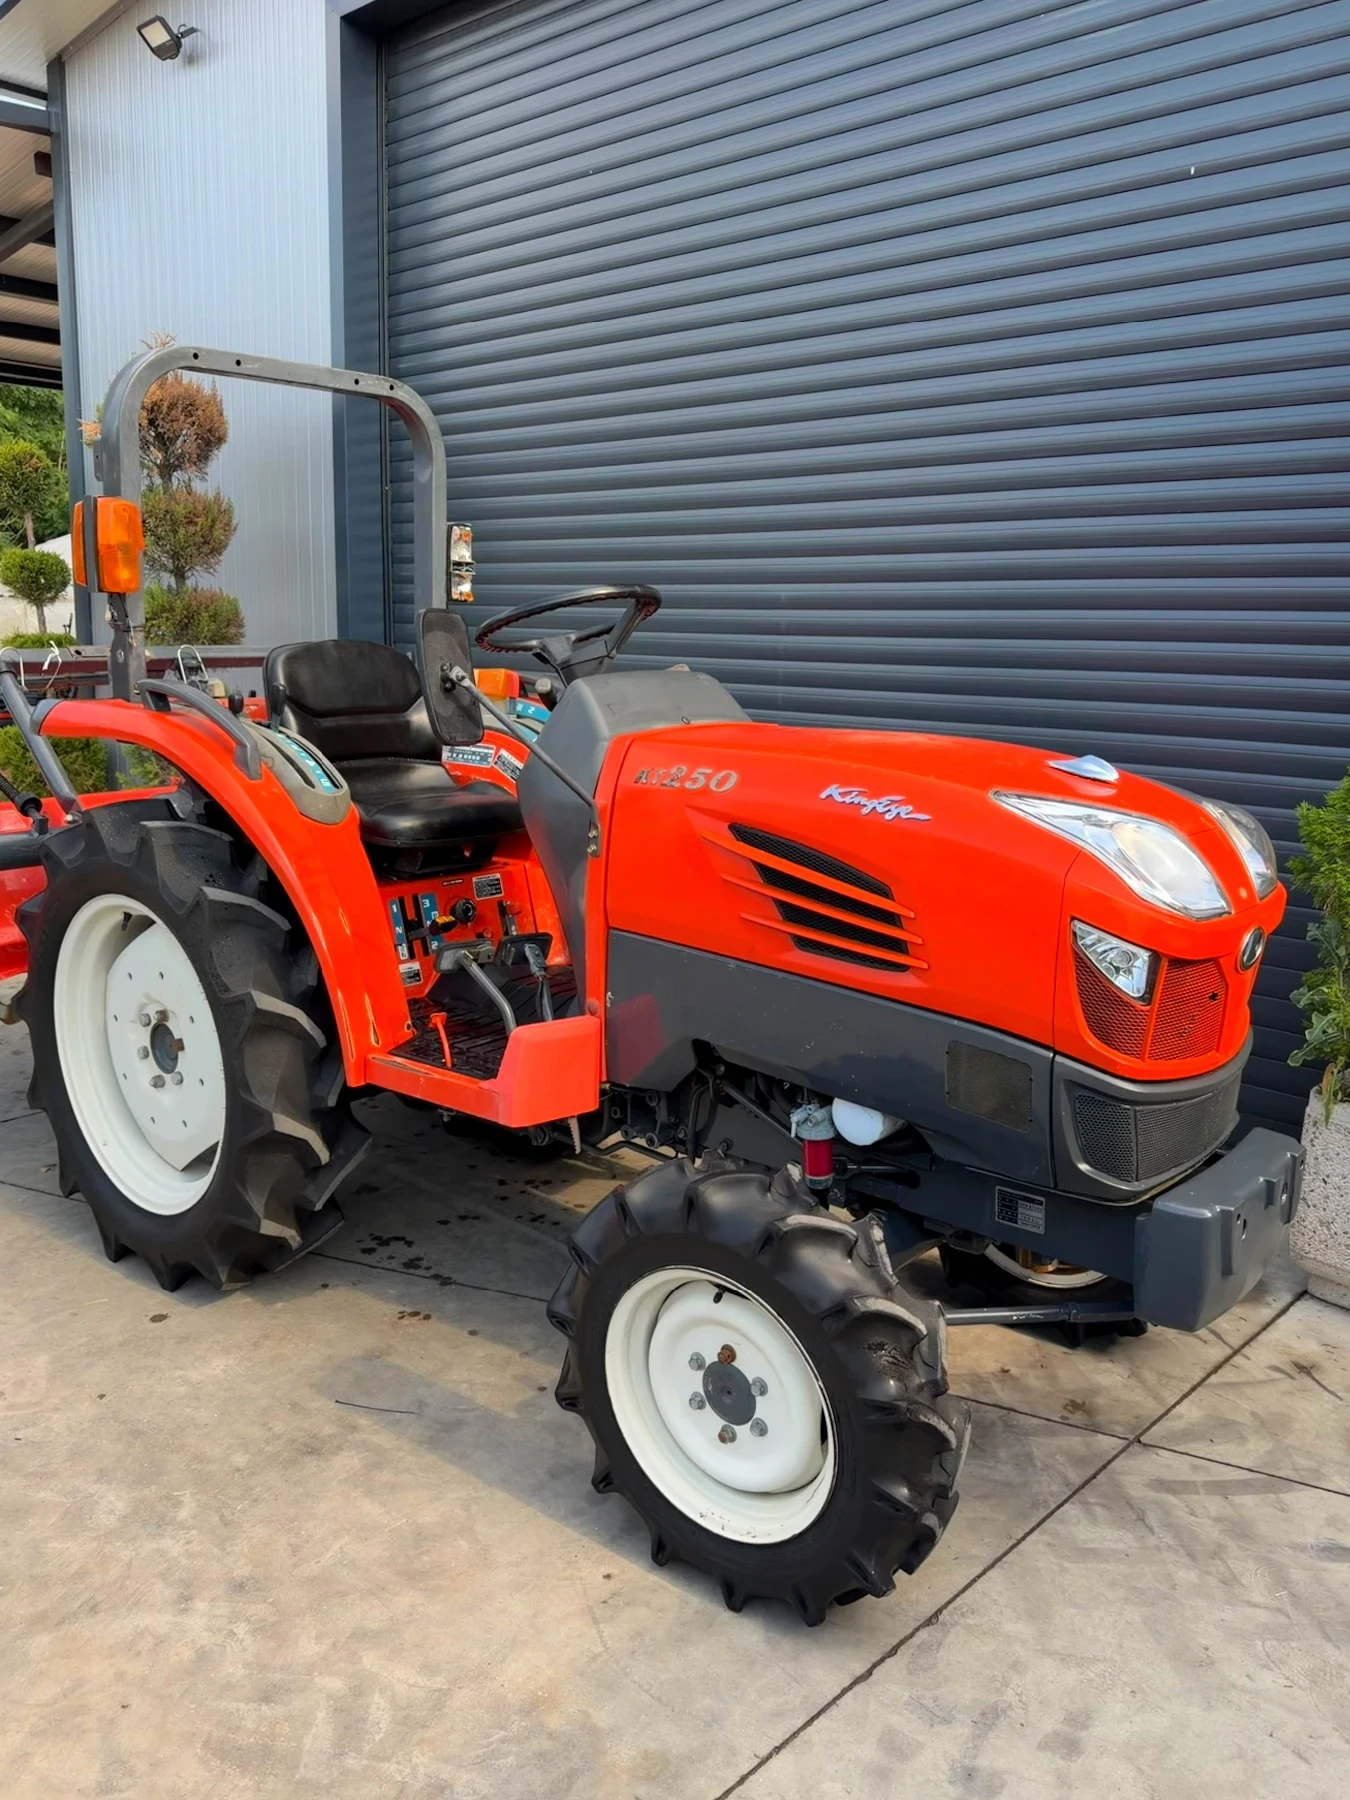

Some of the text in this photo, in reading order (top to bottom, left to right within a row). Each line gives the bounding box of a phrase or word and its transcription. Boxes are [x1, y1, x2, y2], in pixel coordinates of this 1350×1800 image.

[422, 899, 430, 908] 3
[392, 904, 397, 913] 1
[431, 941, 439, 950] 2
